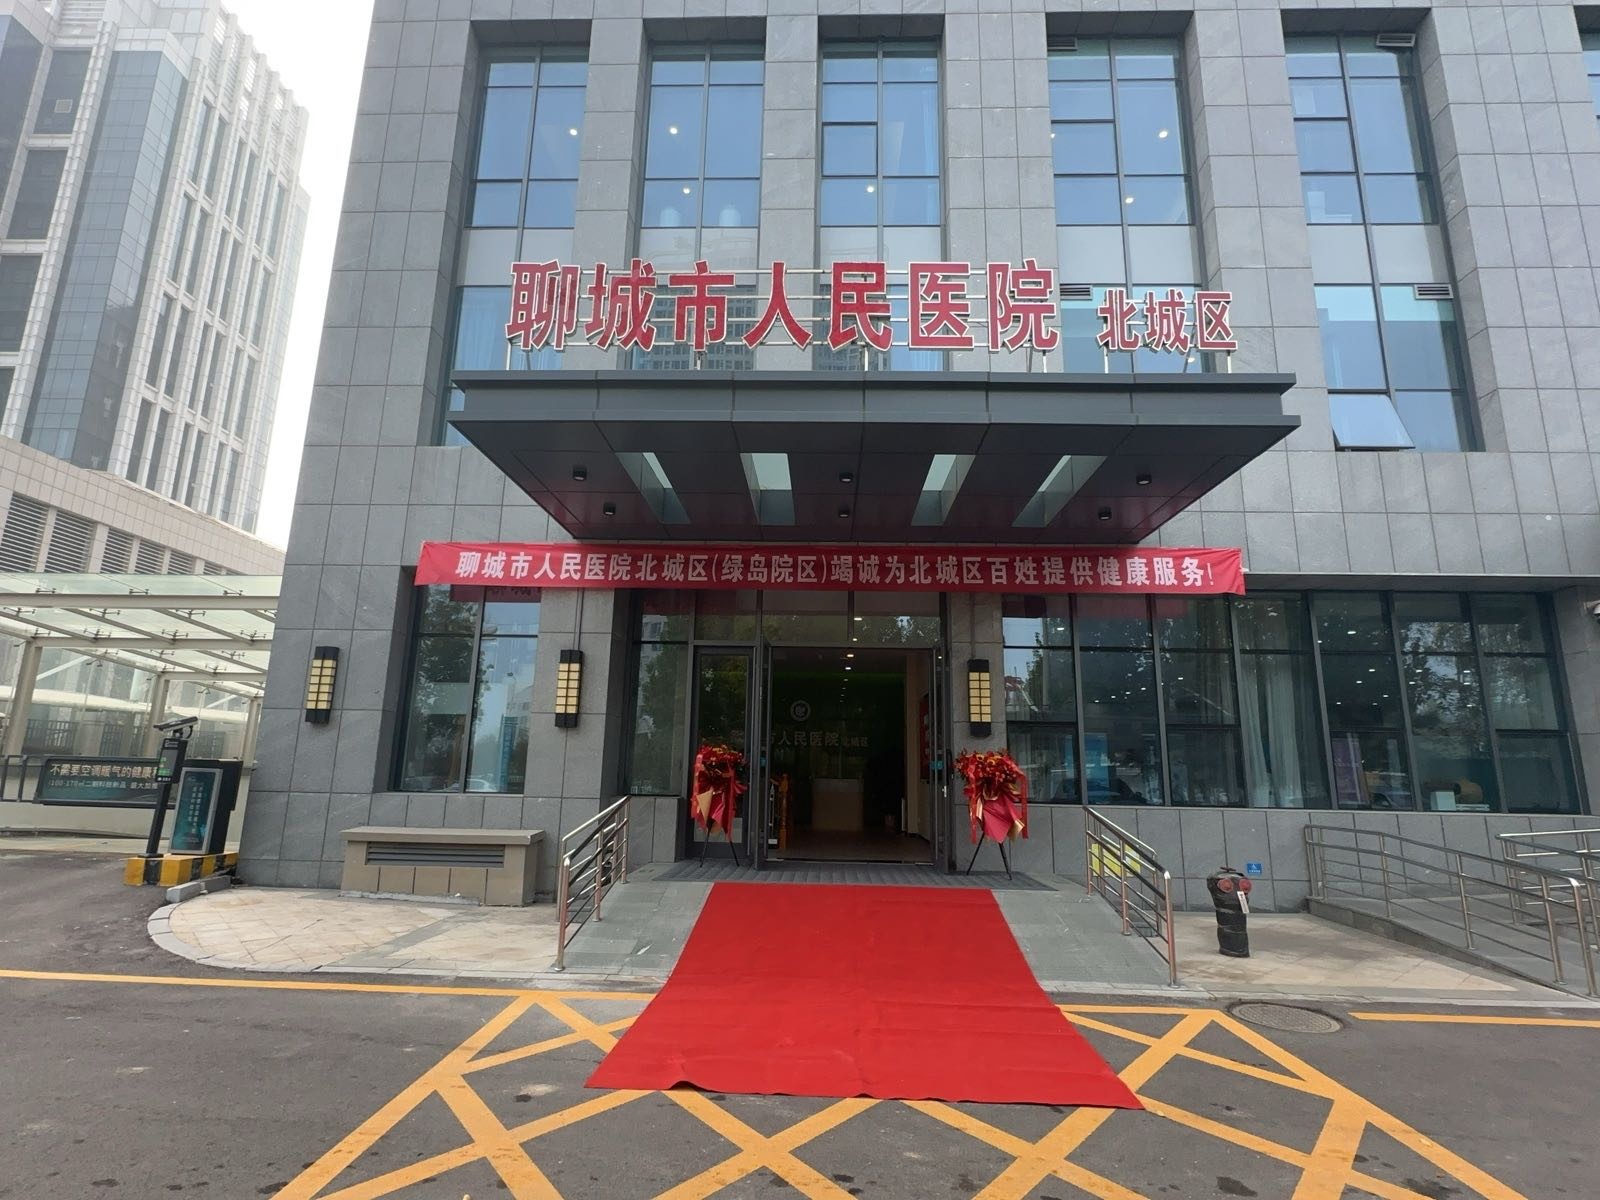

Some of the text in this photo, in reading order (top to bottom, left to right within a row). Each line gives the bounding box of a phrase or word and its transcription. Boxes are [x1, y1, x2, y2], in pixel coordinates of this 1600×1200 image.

[506, 258, 1238, 353] 聊城市人民医院 北城区
